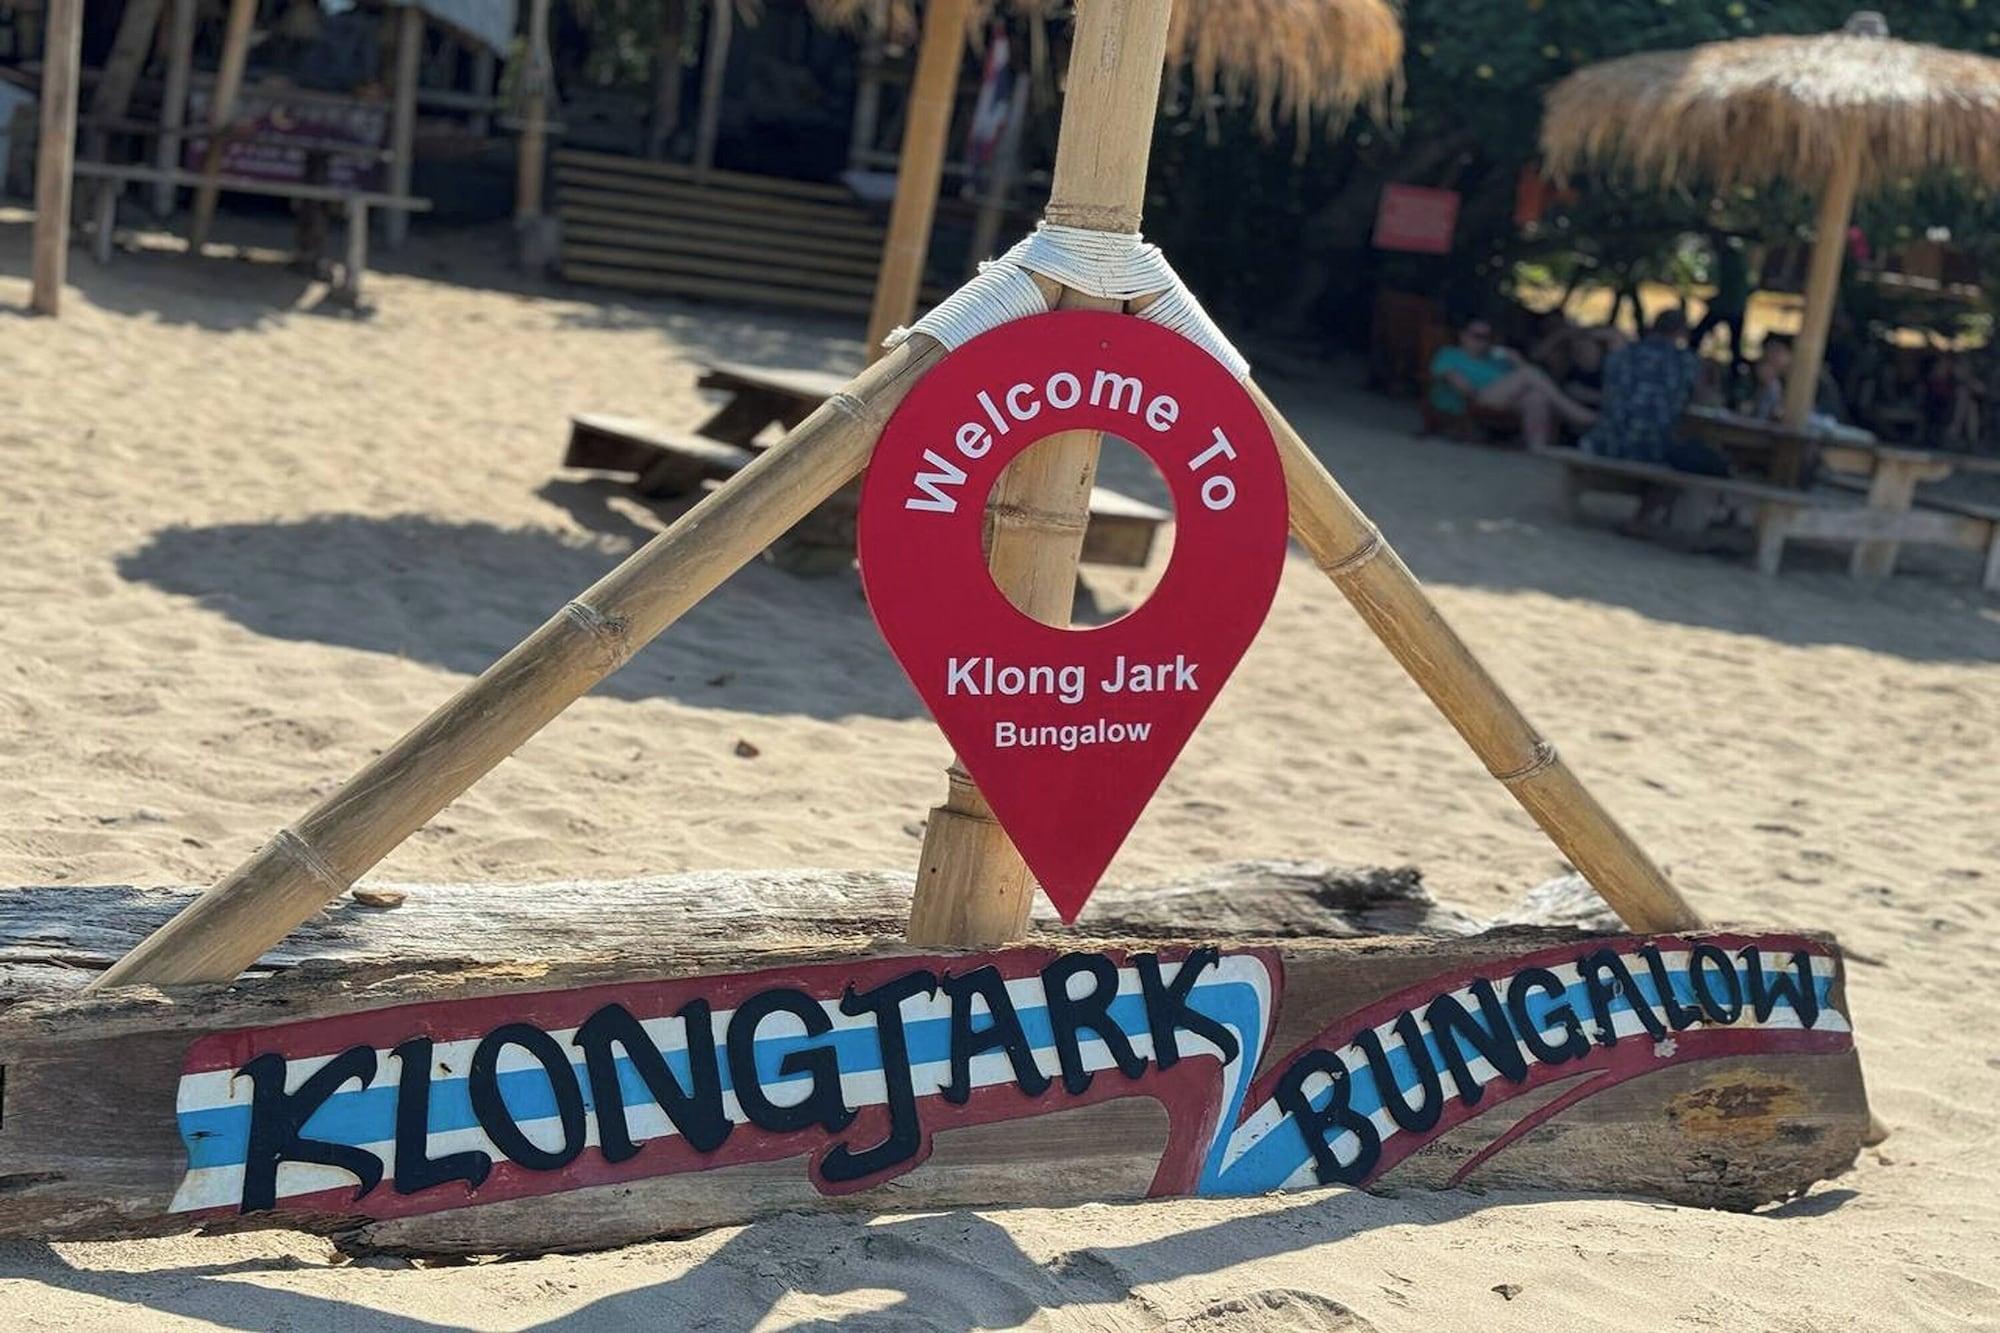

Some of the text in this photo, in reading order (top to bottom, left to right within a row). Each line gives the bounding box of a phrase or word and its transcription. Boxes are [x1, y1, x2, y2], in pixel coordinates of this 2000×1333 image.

[905, 370, 1237, 513] Welcome To
[946, 654, 1200, 704] Klong Jark
[994, 719, 1152, 751] Bungalow
[1274, 943, 1820, 1187] BUNGALOW
